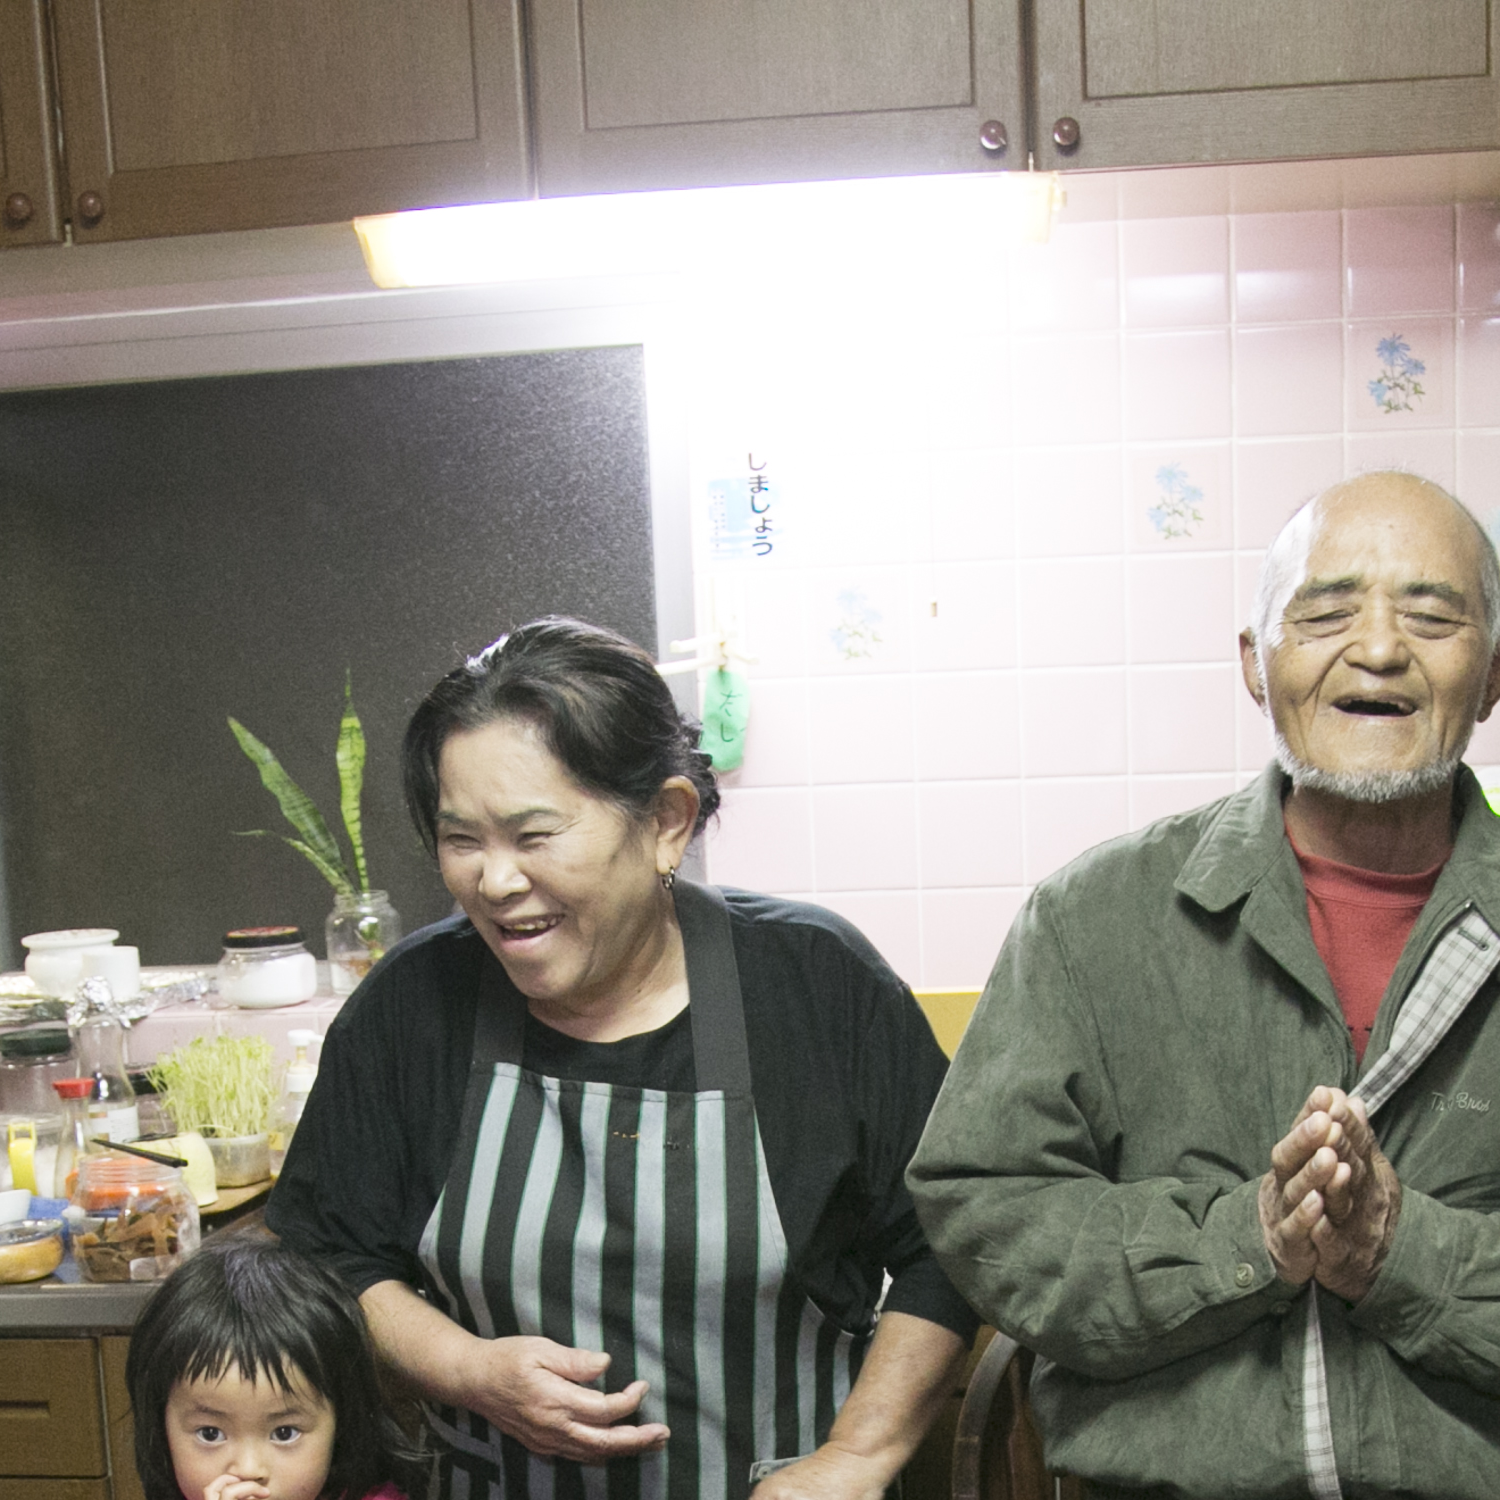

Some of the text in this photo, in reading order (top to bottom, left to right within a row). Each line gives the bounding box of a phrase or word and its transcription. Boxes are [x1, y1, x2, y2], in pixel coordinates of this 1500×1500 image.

[748, 453, 773, 556] しましょう
